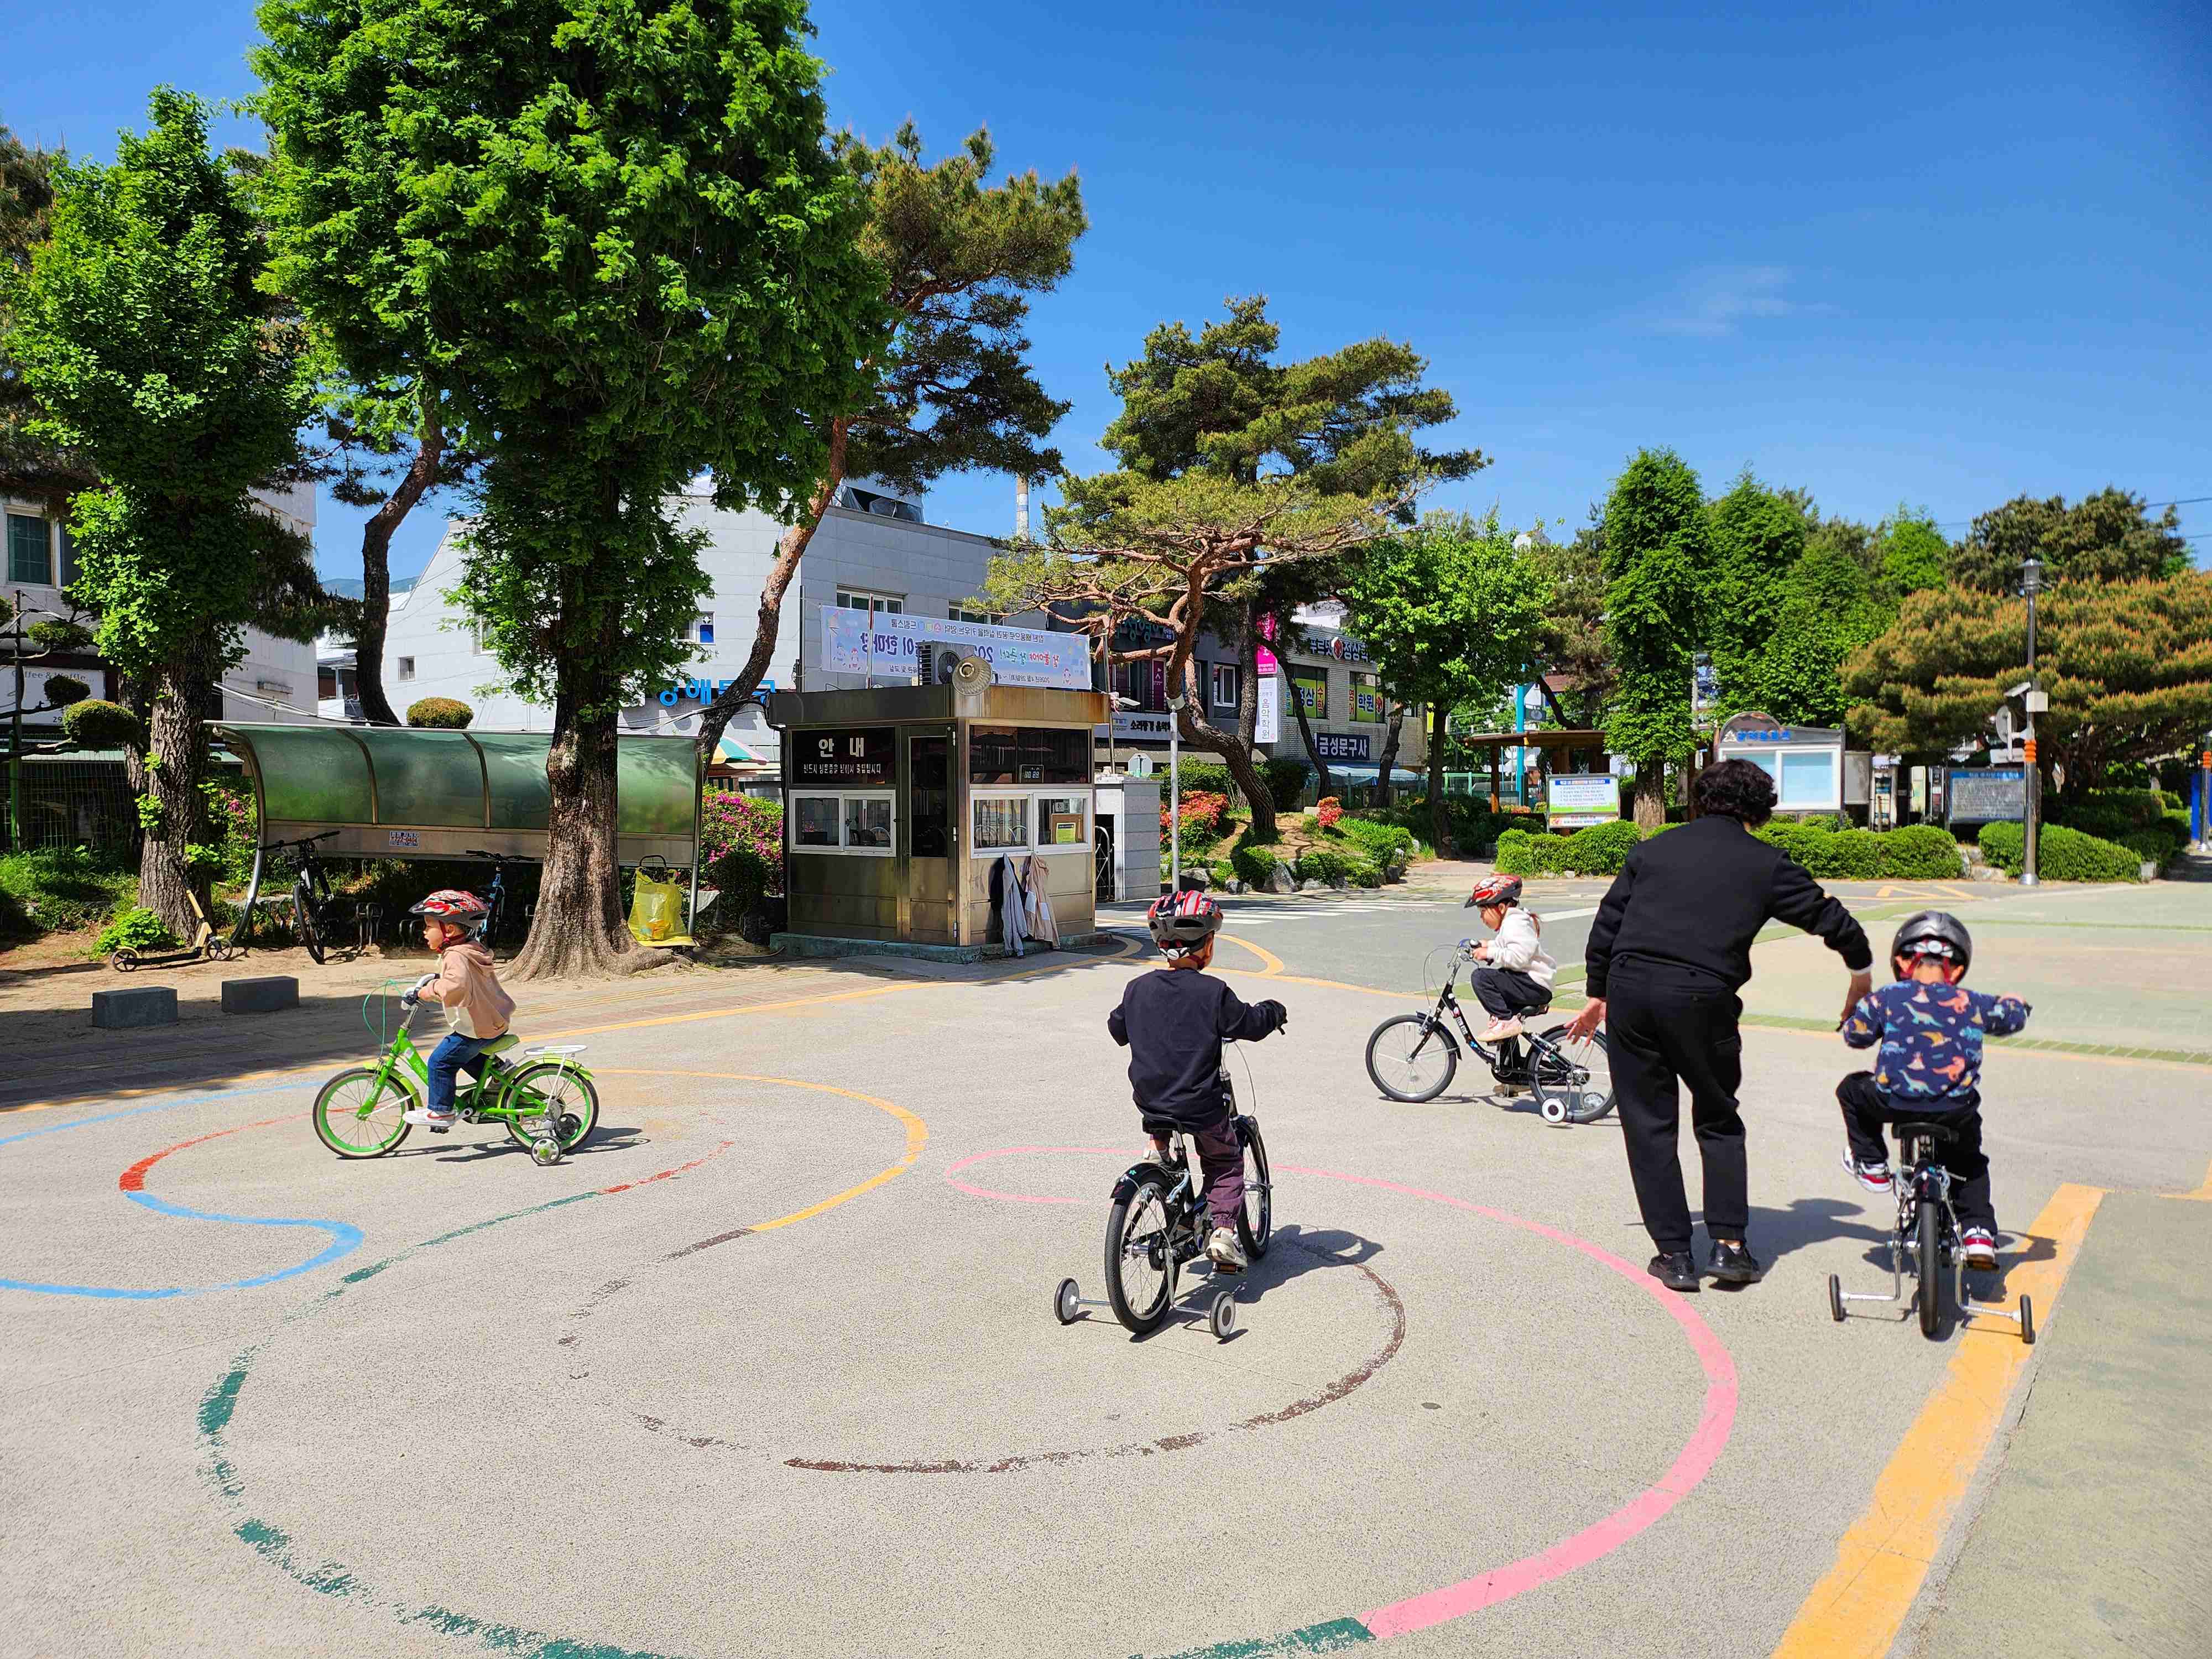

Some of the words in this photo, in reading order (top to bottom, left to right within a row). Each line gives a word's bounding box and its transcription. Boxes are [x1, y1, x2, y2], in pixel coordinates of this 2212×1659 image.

[1344, 641, 1370, 664] 정상학
[1358, 693, 1374, 712] 학원
[1156, 721, 1171, 732] 음악
[1261, 698, 1270, 739] 음악학원
[818, 738, 834, 757] 안
[849, 737, 864, 757] 내
[1319, 737, 1368, 757] 금성문구사
